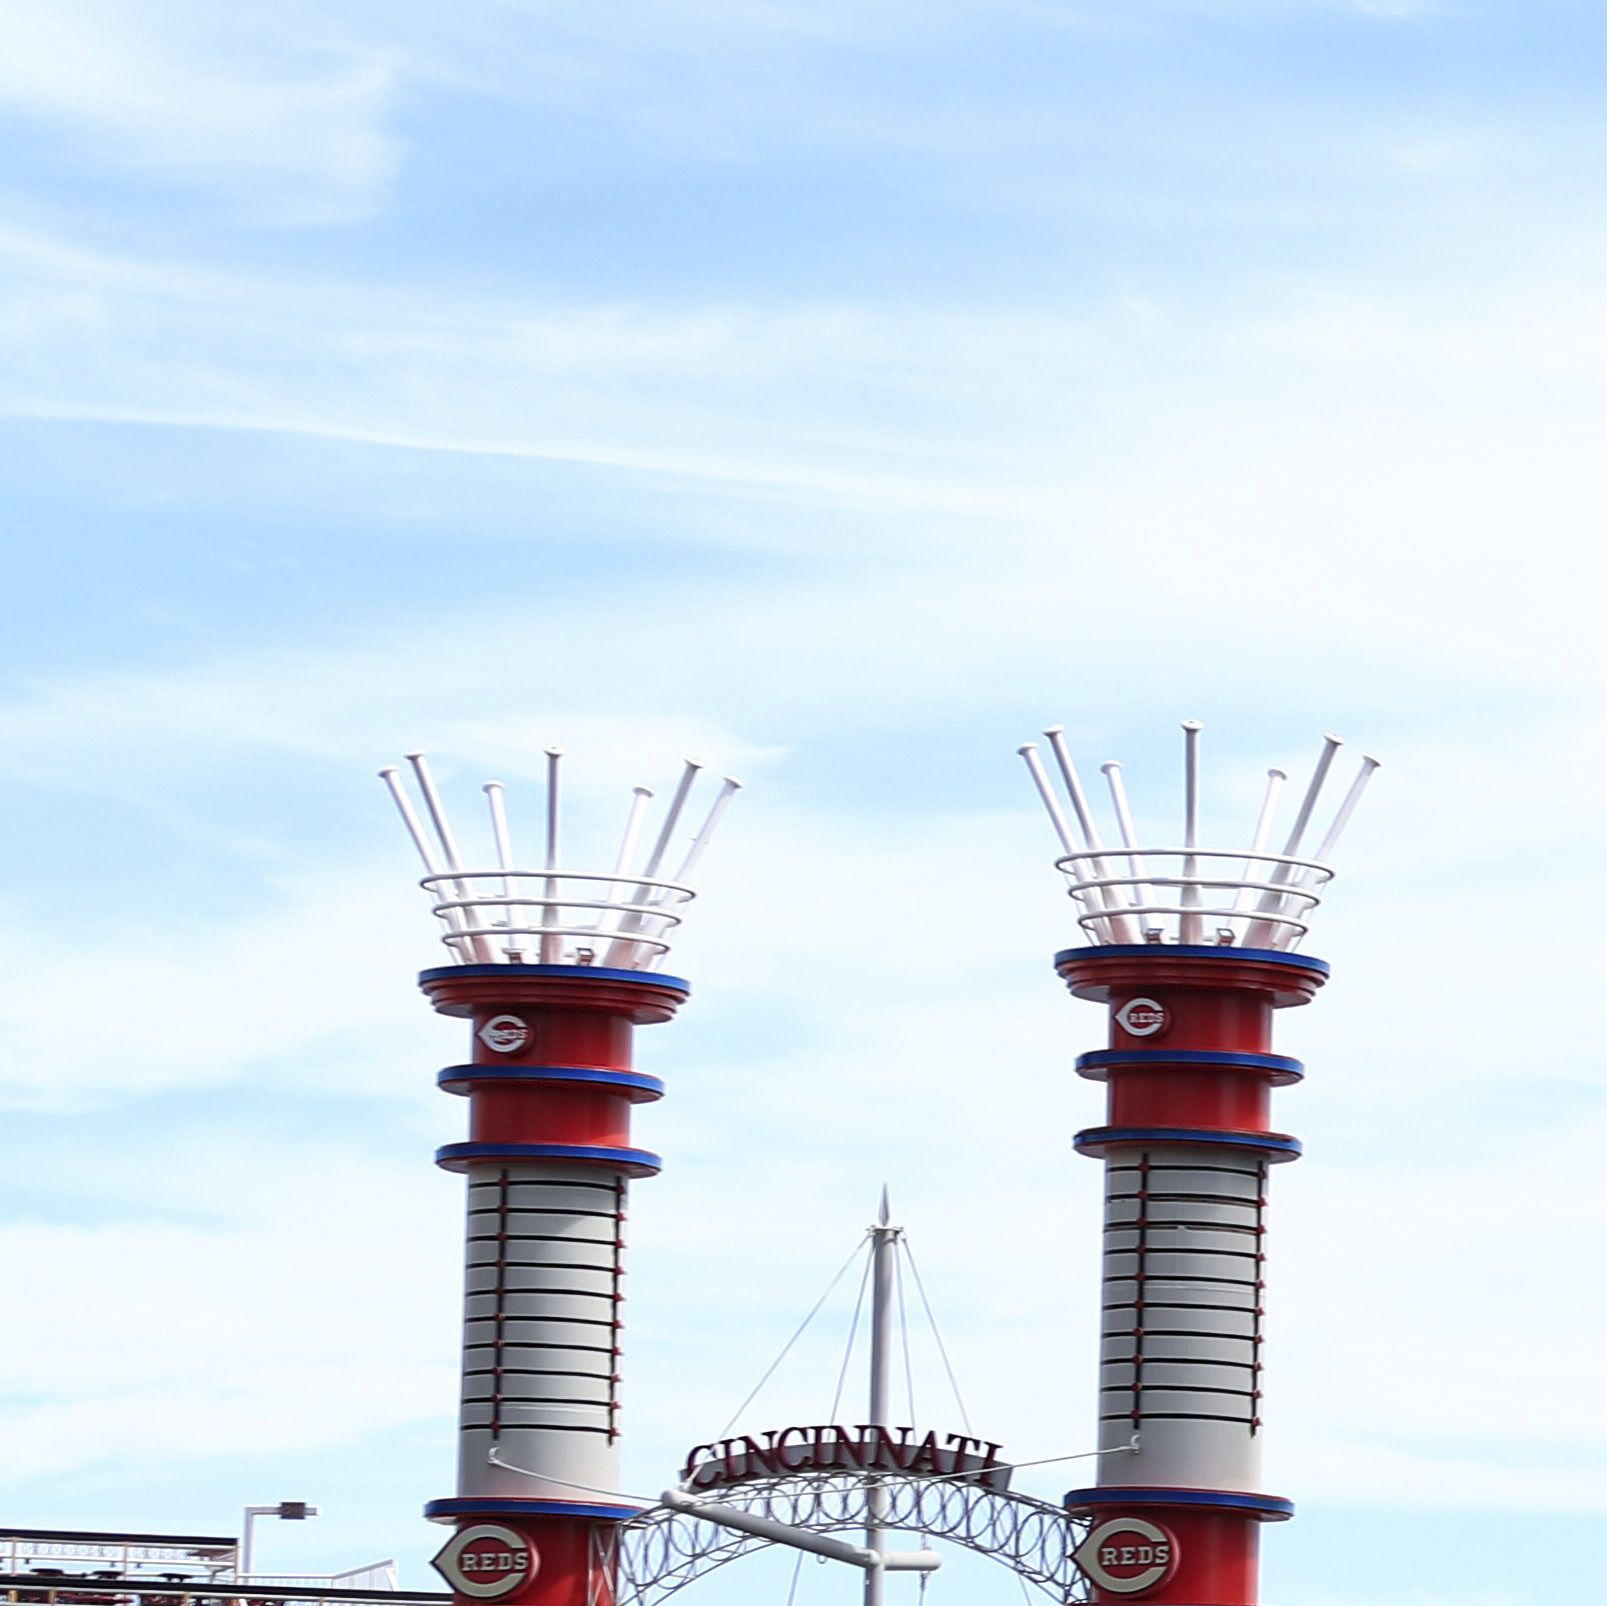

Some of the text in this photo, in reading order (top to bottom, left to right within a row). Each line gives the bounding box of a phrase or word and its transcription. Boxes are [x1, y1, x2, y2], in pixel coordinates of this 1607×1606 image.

[686, 1424, 1003, 1488] CINCINNATI
[461, 1552, 528, 1573] REDS
[1101, 1544, 1170, 1567] REDS
